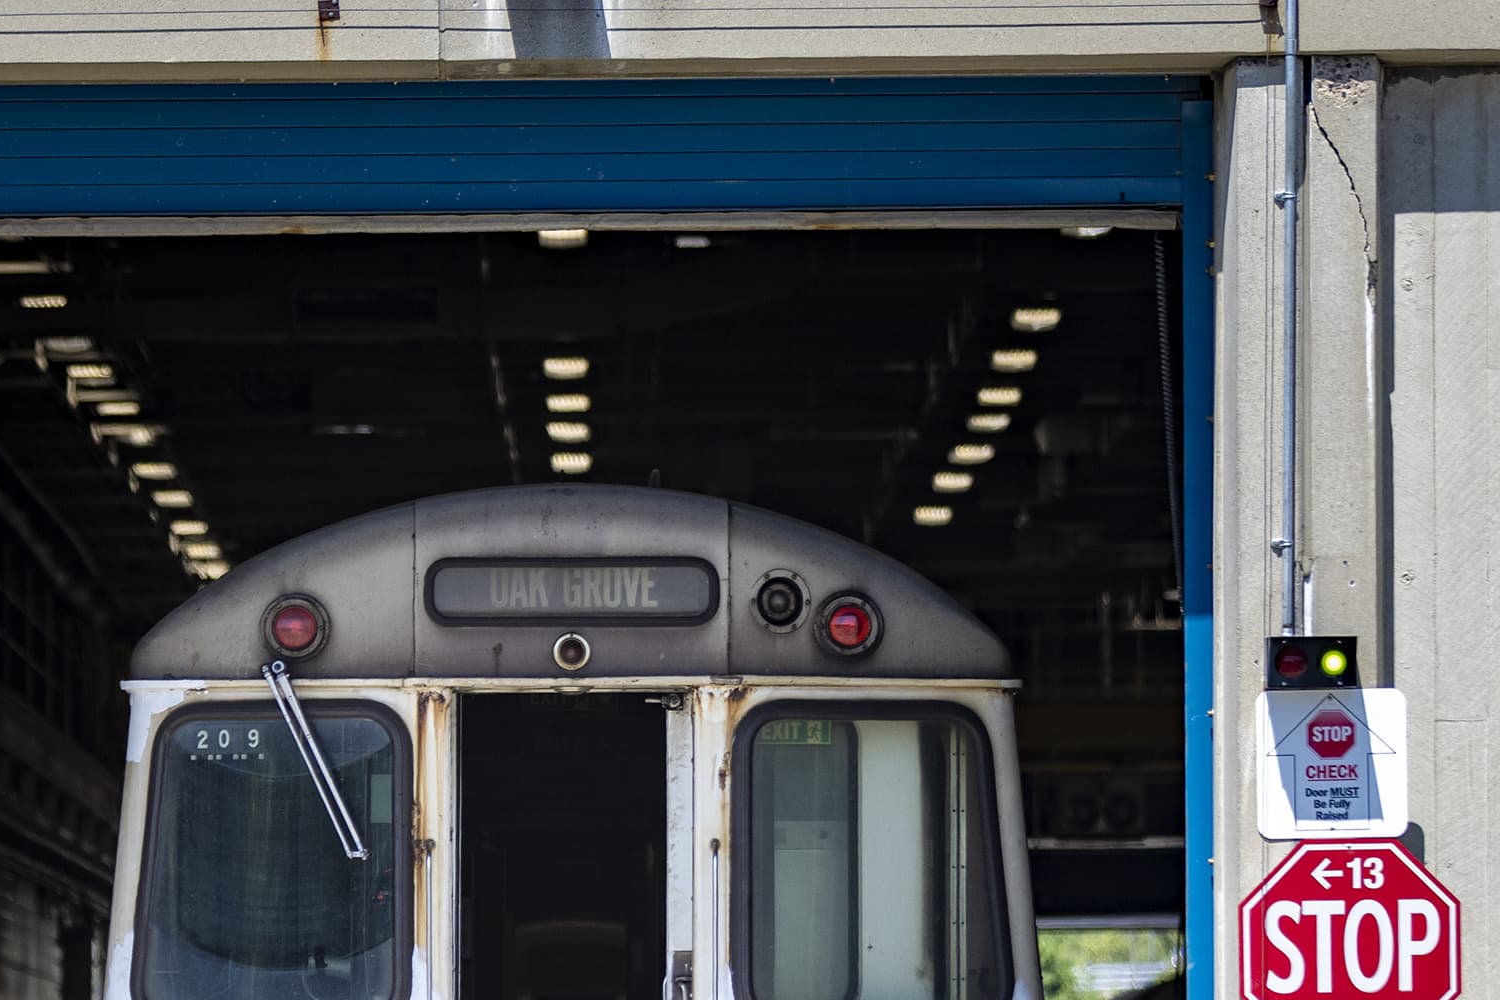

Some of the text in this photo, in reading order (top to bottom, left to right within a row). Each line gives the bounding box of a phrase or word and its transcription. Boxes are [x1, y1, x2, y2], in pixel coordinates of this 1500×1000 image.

[563, 567, 658, 608] GROVE
[1312, 726, 1352, 742] STOP
[1306, 764, 1358, 779] CHECK
[1305, 787, 1359, 797] Door MUST
[1314, 800, 1351, 809] Be Fully
[1316, 811, 1348, 820] Raised
[1346, 857, 1385, 889] 13
[1265, 899, 1441, 994] STOP
